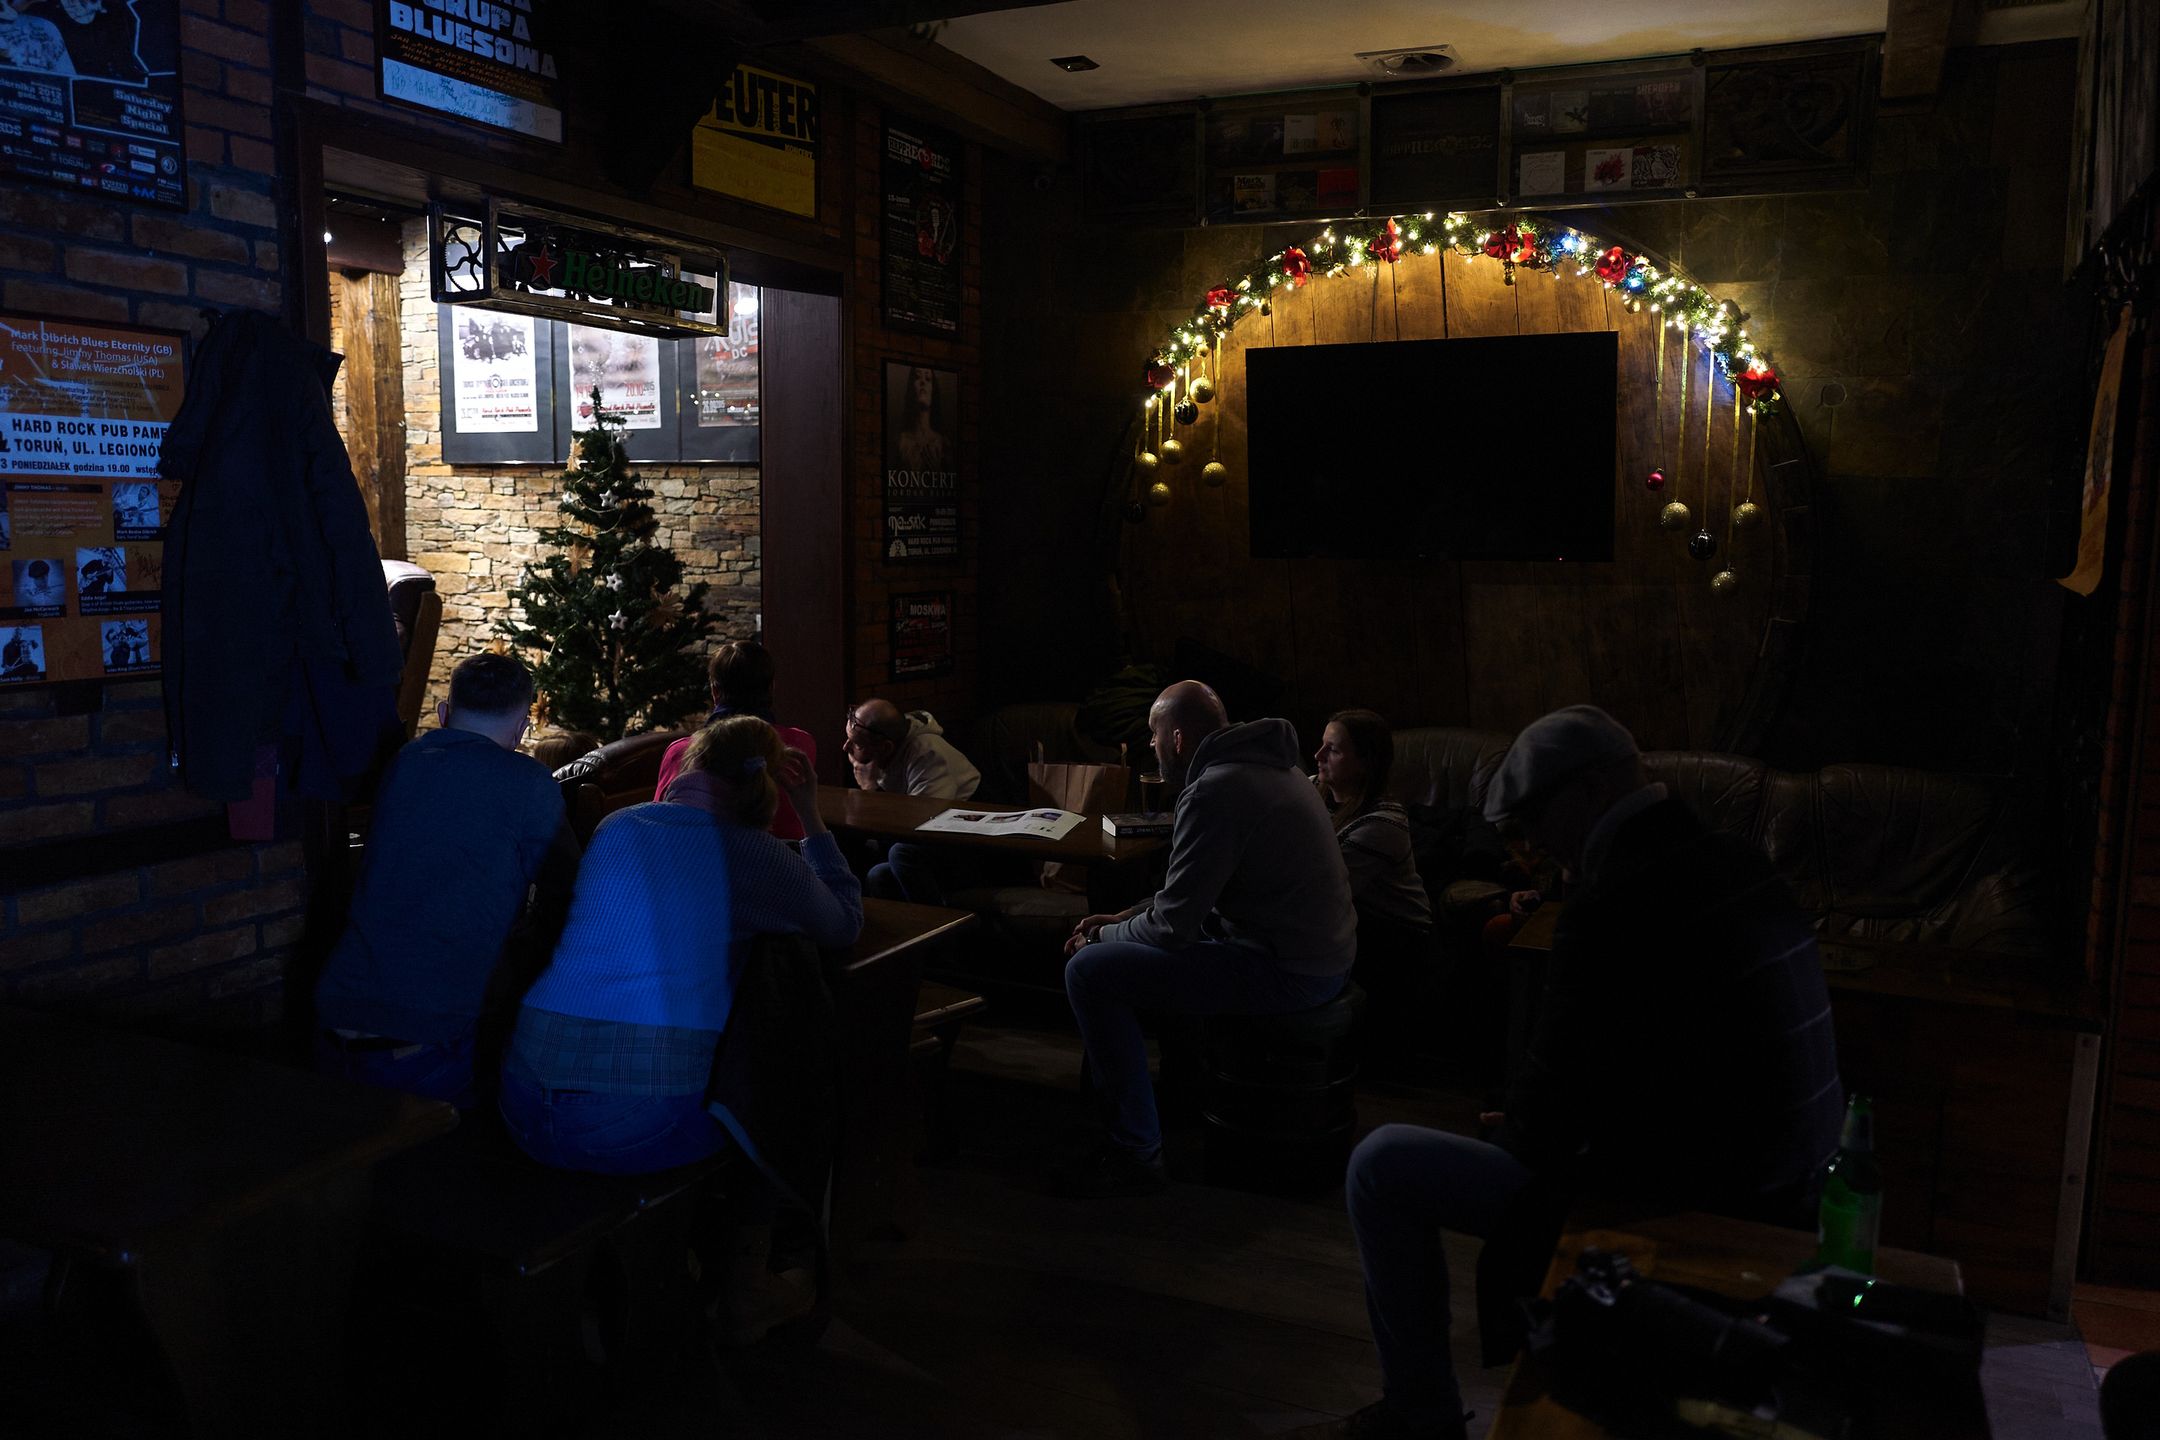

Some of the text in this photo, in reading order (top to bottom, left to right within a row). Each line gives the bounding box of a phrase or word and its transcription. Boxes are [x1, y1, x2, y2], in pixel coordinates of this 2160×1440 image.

[389, 0, 558, 80] BLUESOWA
[114, 88, 173, 114] Saturday
[125, 103, 163, 121] Night
[121, 114, 169, 135] Special
[561, 250, 704, 313] Heineken
[11, 330, 173, 356] Mark Olbrich Blues Eternity (GB)
[12, 341, 159, 366] Featuring Jimmy Thomas (USA)
[51, 359, 59, 369] &
[149, 368, 165, 380] (PL)
[12, 418, 52, 433] HARD
[57, 421, 96, 436] ROCK
[101, 424, 128, 438] PUB
[14, 437, 68, 456] TORUŃ,
[73, 441, 94, 454] UL.
[12, 460, 70, 471] PONIEDZIAŁEK
[73, 462, 105, 473] godzina
[107, 463, 130, 473] 19.00
[888, 470, 957, 488] KONCERT
[910, 604, 946, 616] MOSKWA
